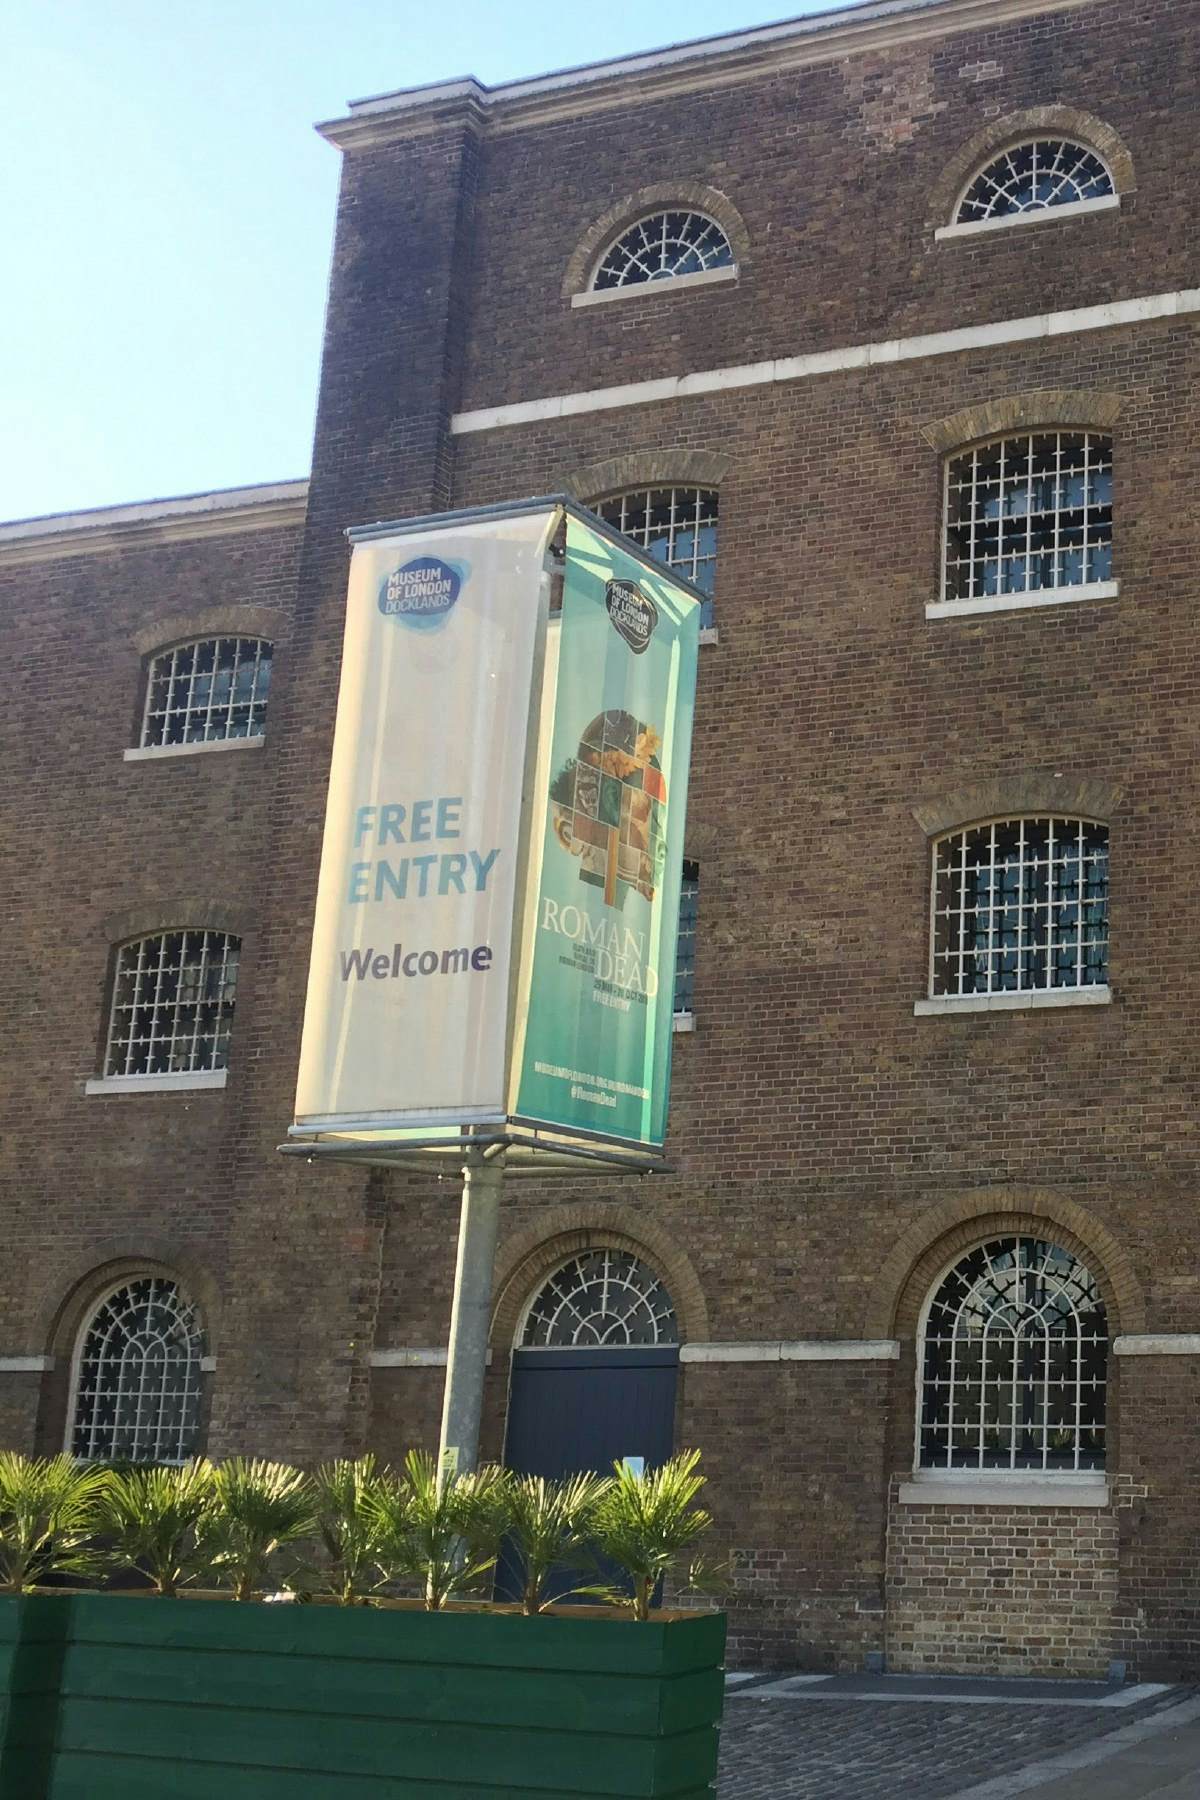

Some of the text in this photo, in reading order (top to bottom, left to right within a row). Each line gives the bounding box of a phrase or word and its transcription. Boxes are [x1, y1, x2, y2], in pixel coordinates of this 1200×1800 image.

[386, 579, 452, 600] OF LONDON
[388, 567, 441, 587] MUSEUM
[385, 593, 450, 613] DOCKLANDS
[612, 583, 643, 611] MUSEUM
[621, 601, 649, 626] LONDON
[353, 797, 463, 848] FREE
[348, 848, 500, 904] ENTRY
[541, 897, 646, 961] ROMAN
[340, 943, 493, 981] Welcome
[594, 947, 659, 997] DEAD
